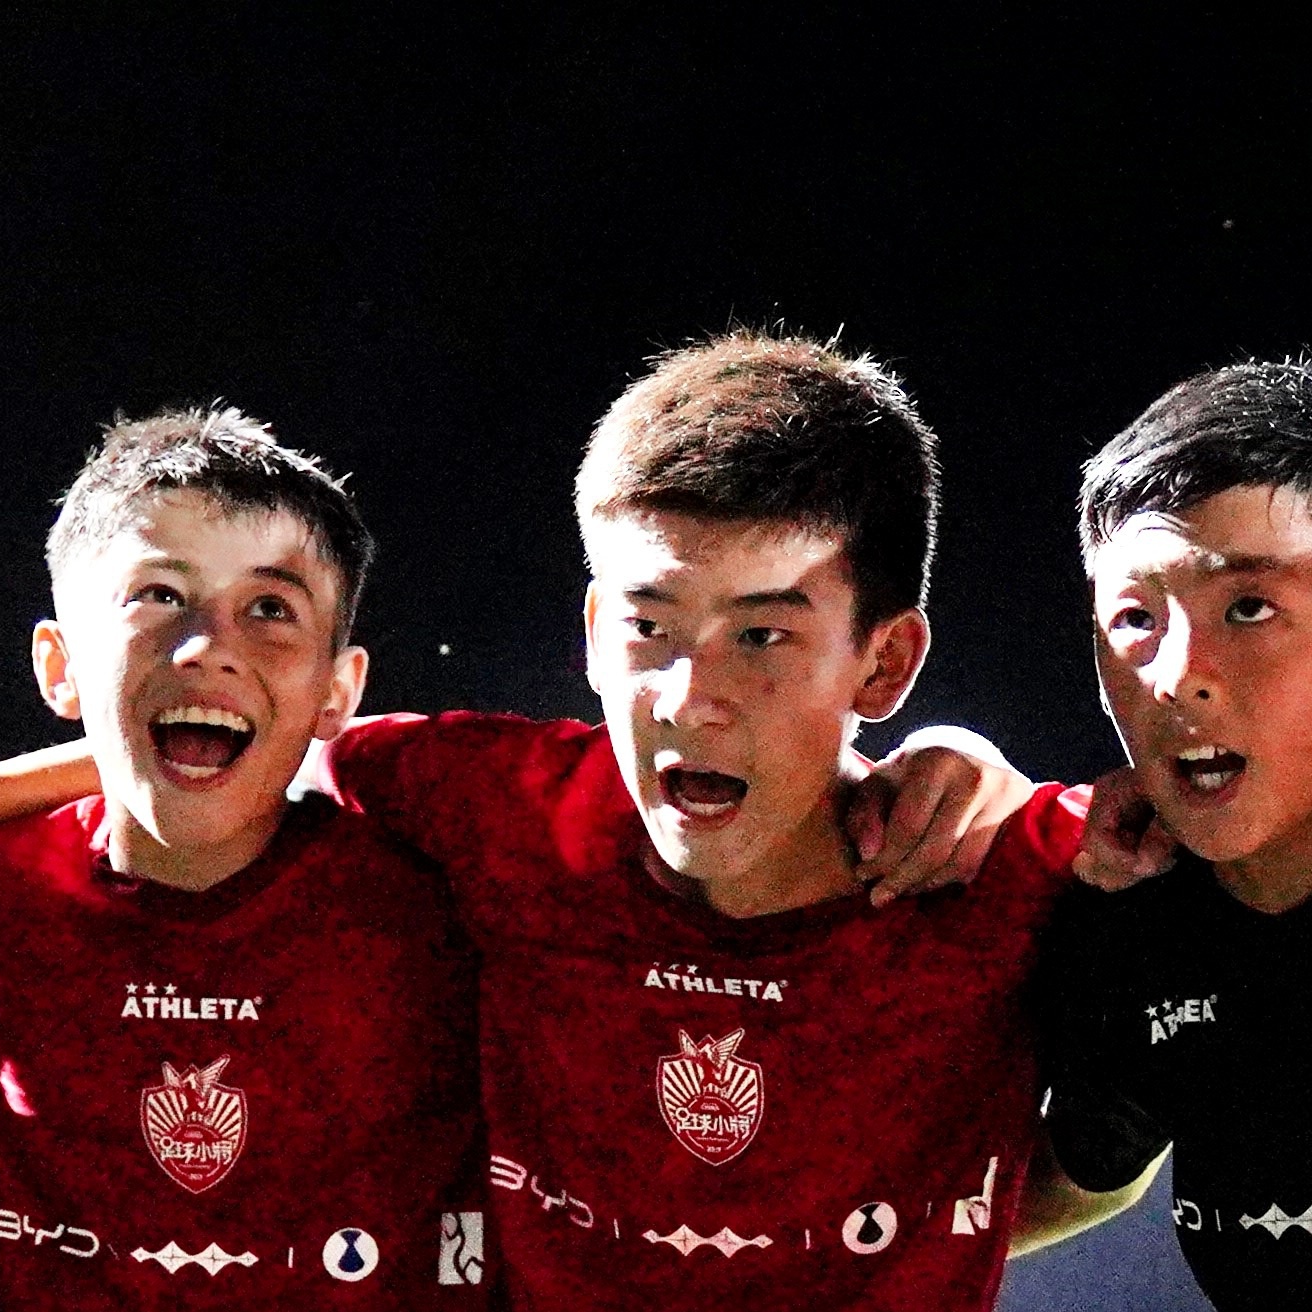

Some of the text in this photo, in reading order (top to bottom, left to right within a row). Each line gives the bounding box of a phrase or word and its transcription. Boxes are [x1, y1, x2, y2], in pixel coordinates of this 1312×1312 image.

[644, 969, 783, 1002] ATHLETA
[121, 996, 259, 1021] ATHLETA
[490, 1155, 594, 1228] BYD
